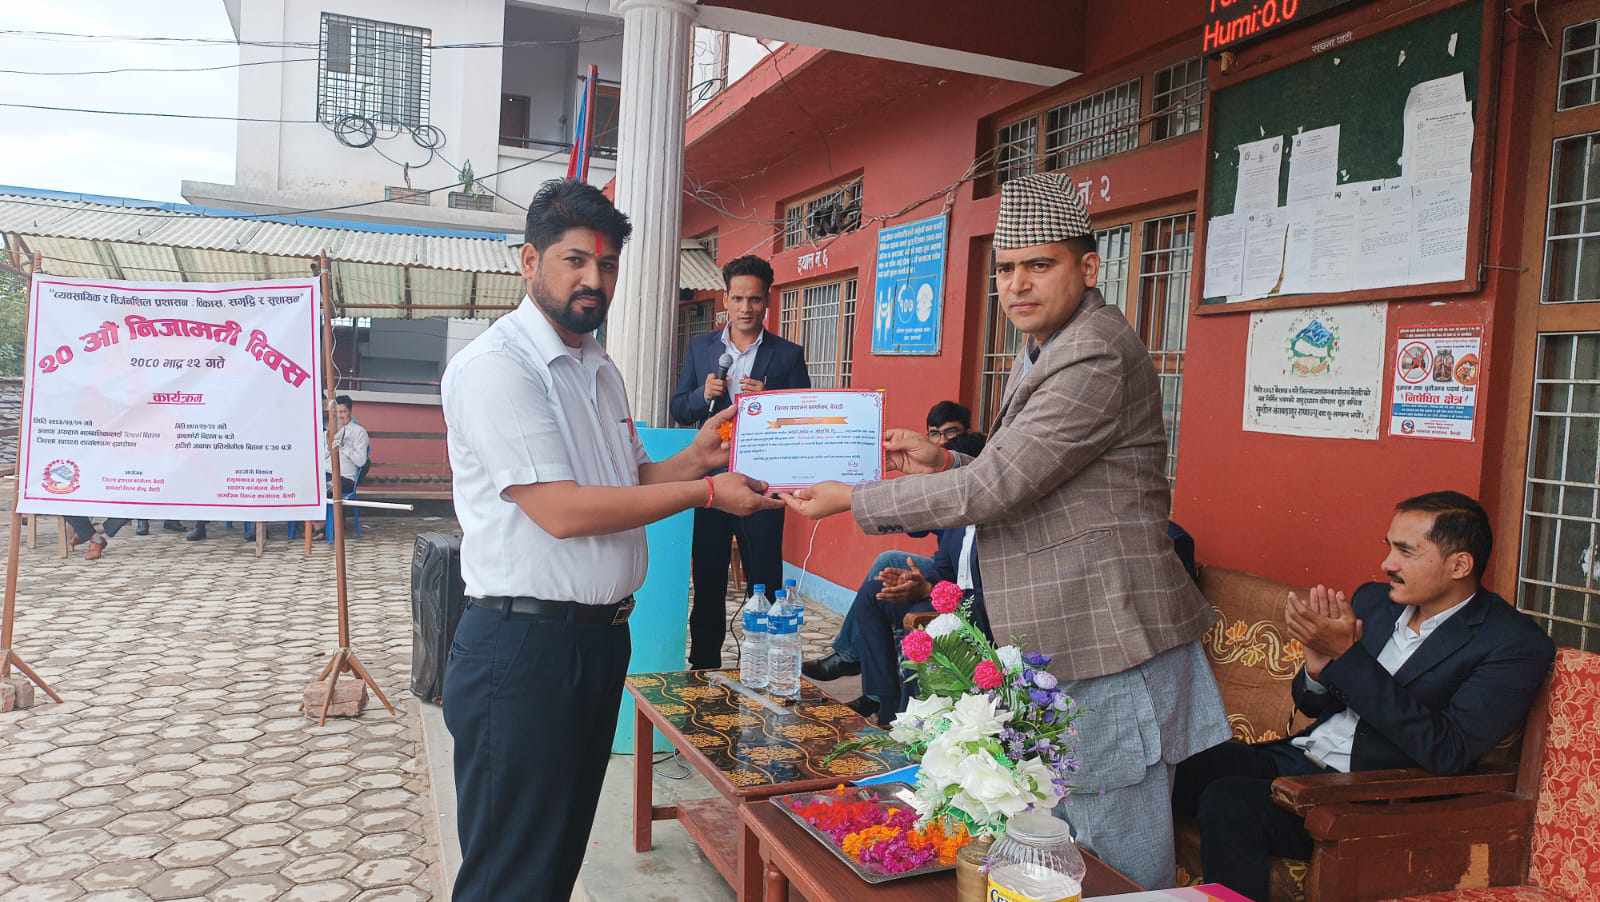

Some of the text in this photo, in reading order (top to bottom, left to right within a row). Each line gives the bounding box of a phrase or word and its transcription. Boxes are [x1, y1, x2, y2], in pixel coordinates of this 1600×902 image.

[1100, 175, 1111, 202] २
[103, 294, 109, 304] र
[258, 296, 265, 305] र
[38, 344, 75, 375] २०
[124, 313, 243, 348] निजामती
[244, 328, 312, 390] दिवस
[130, 357, 160, 369] २०८०
[205, 356, 226, 369] गते
[153, 390, 204, 404] कार्यक्रम
[1405, 391, 1463, 404] निषेधित क्षेत्र
